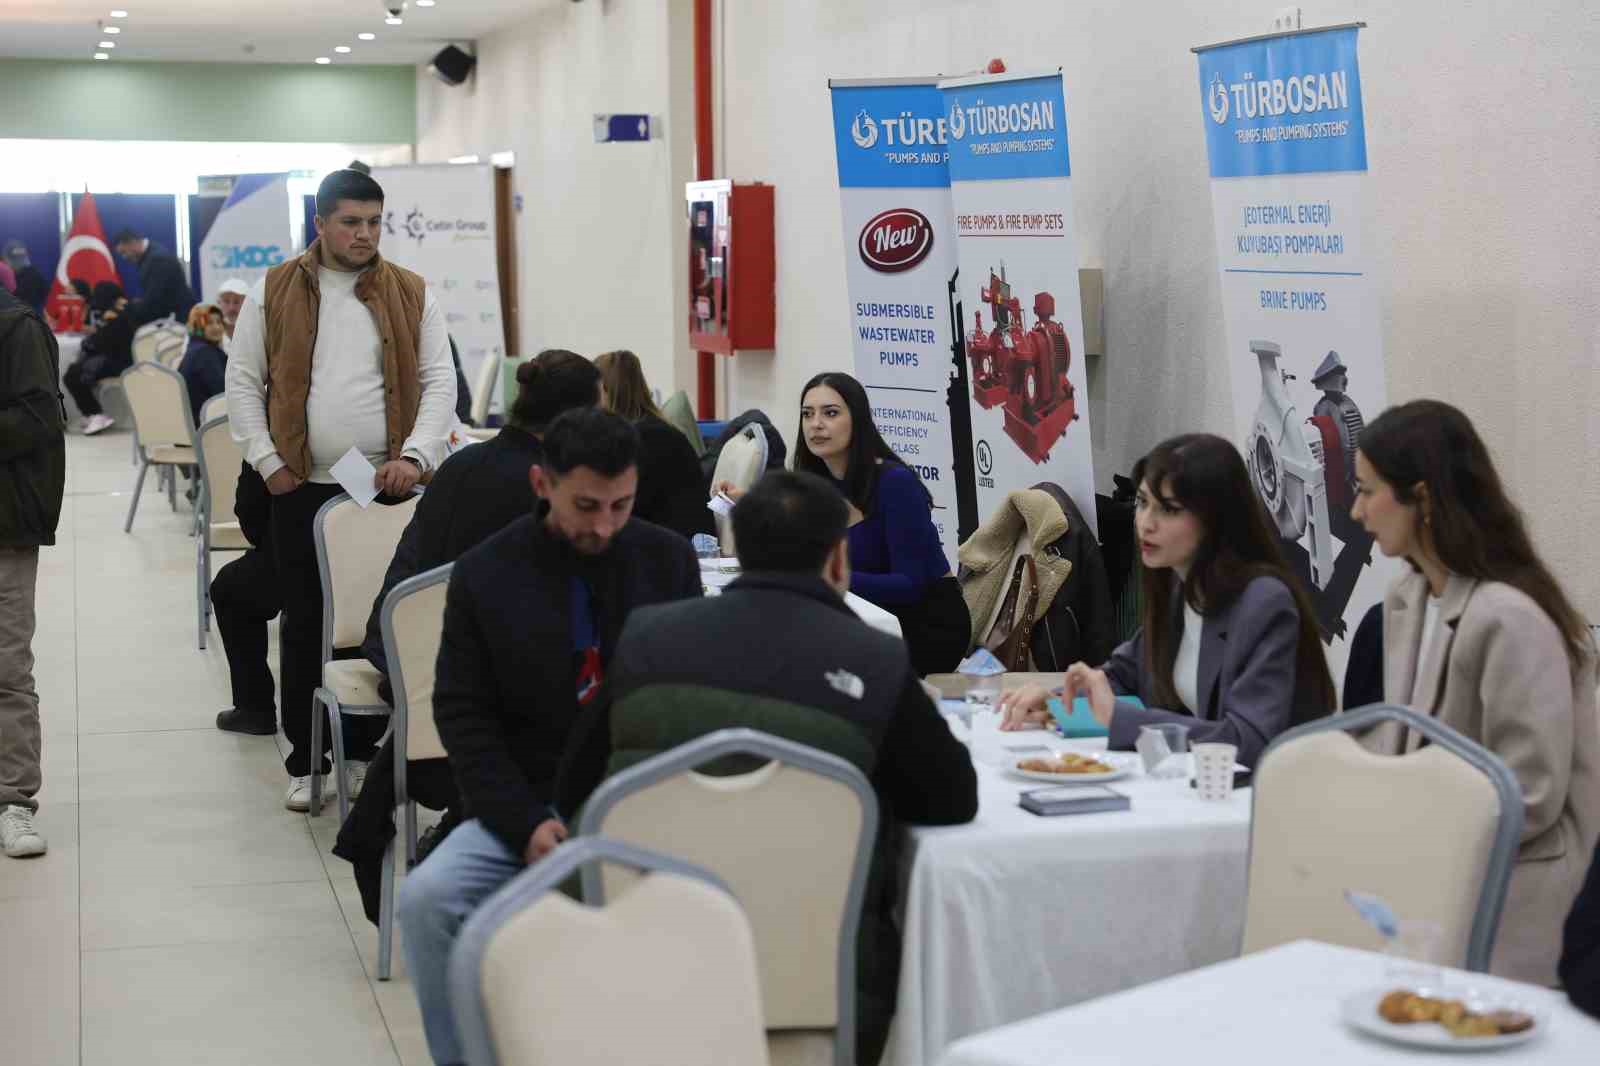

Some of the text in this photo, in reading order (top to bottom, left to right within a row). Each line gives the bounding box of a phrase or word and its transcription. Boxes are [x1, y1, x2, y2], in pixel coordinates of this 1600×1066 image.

[1230, 71, 1348, 119] TÜRBOSAN
[967, 98, 1055, 135] TÜRBOSAN
[1262, 127, 1277, 142] AND
[1278, 125, 1312, 140] PUMPING
[920, 152, 940, 164] AND
[957, 214, 1064, 229] FIRE PUMPS & FIRE PUMP SETS
[1243, 206, 1295, 228] JEOTERMAL
[873, 224, 917, 253] New
[1285, 234, 1344, 253] POMPALARI
[1260, 290, 1327, 311] BRINE PUMPS
[856, 303, 934, 320] SUBMERSIBLE
[858, 327, 935, 344] WASTEWATER
[880, 352, 919, 367] PUMPS
[869, 408, 938, 423] NTERNATIONAL
[891, 442, 920, 455] CLASS
